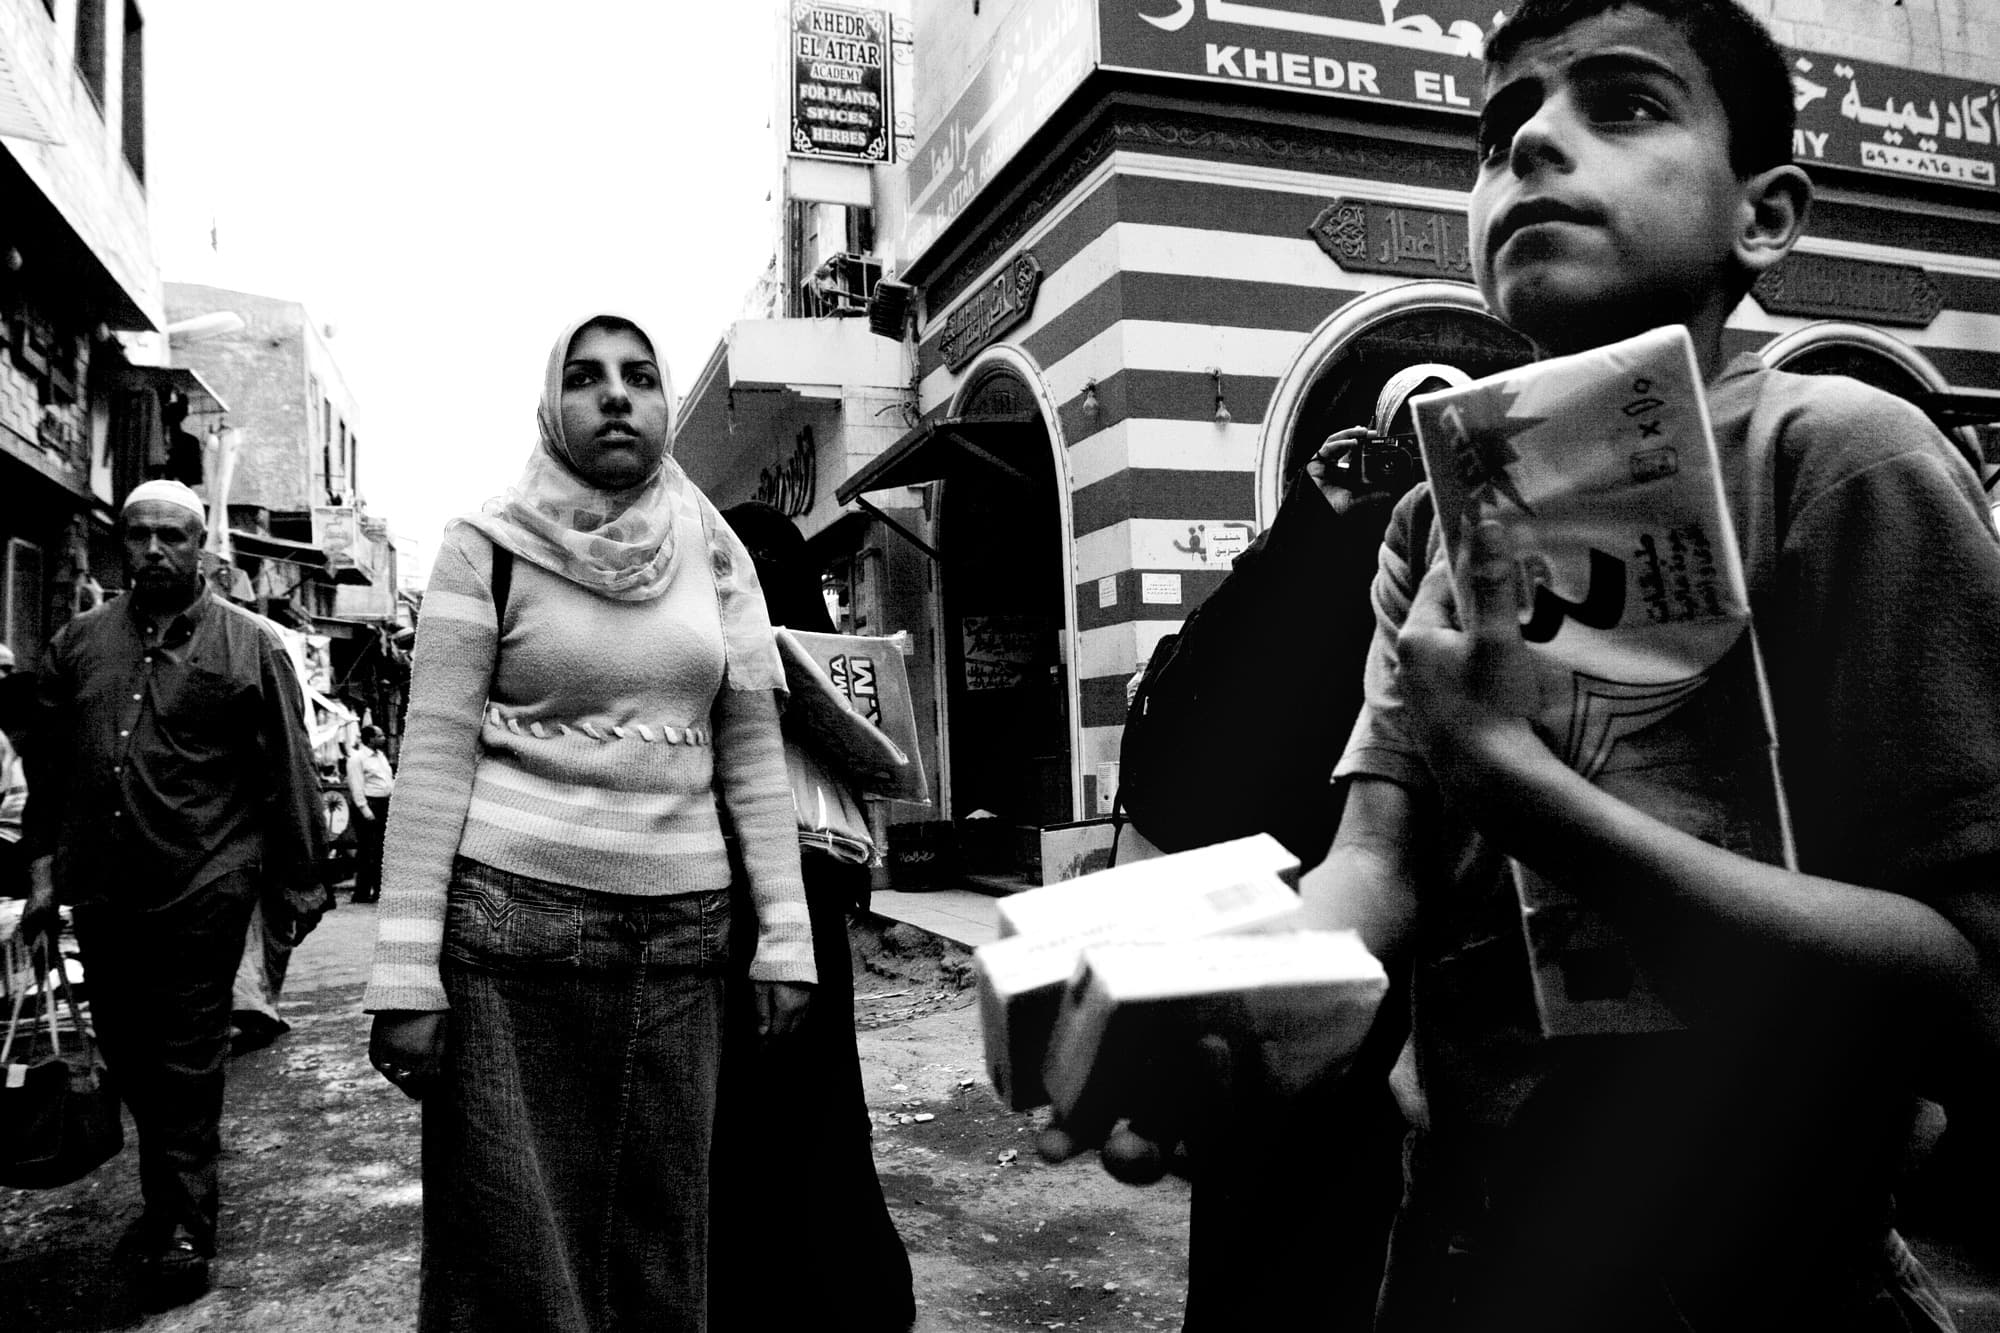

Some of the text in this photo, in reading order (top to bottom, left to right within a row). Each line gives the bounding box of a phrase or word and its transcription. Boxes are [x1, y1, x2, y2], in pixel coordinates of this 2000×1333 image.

[812, 10, 866, 38] KHEDR
[799, 35, 880, 67] EL ATTAR
[811, 64, 863, 82] ACADEMY
[1205, 43, 1471, 106] KHEDR EL
[800, 83, 880, 109] FOR PLANTS,
[806, 107, 873, 127] SPICES,
[811, 127, 867, 146] HERBES
[948, 167, 975, 220] ATTAR
